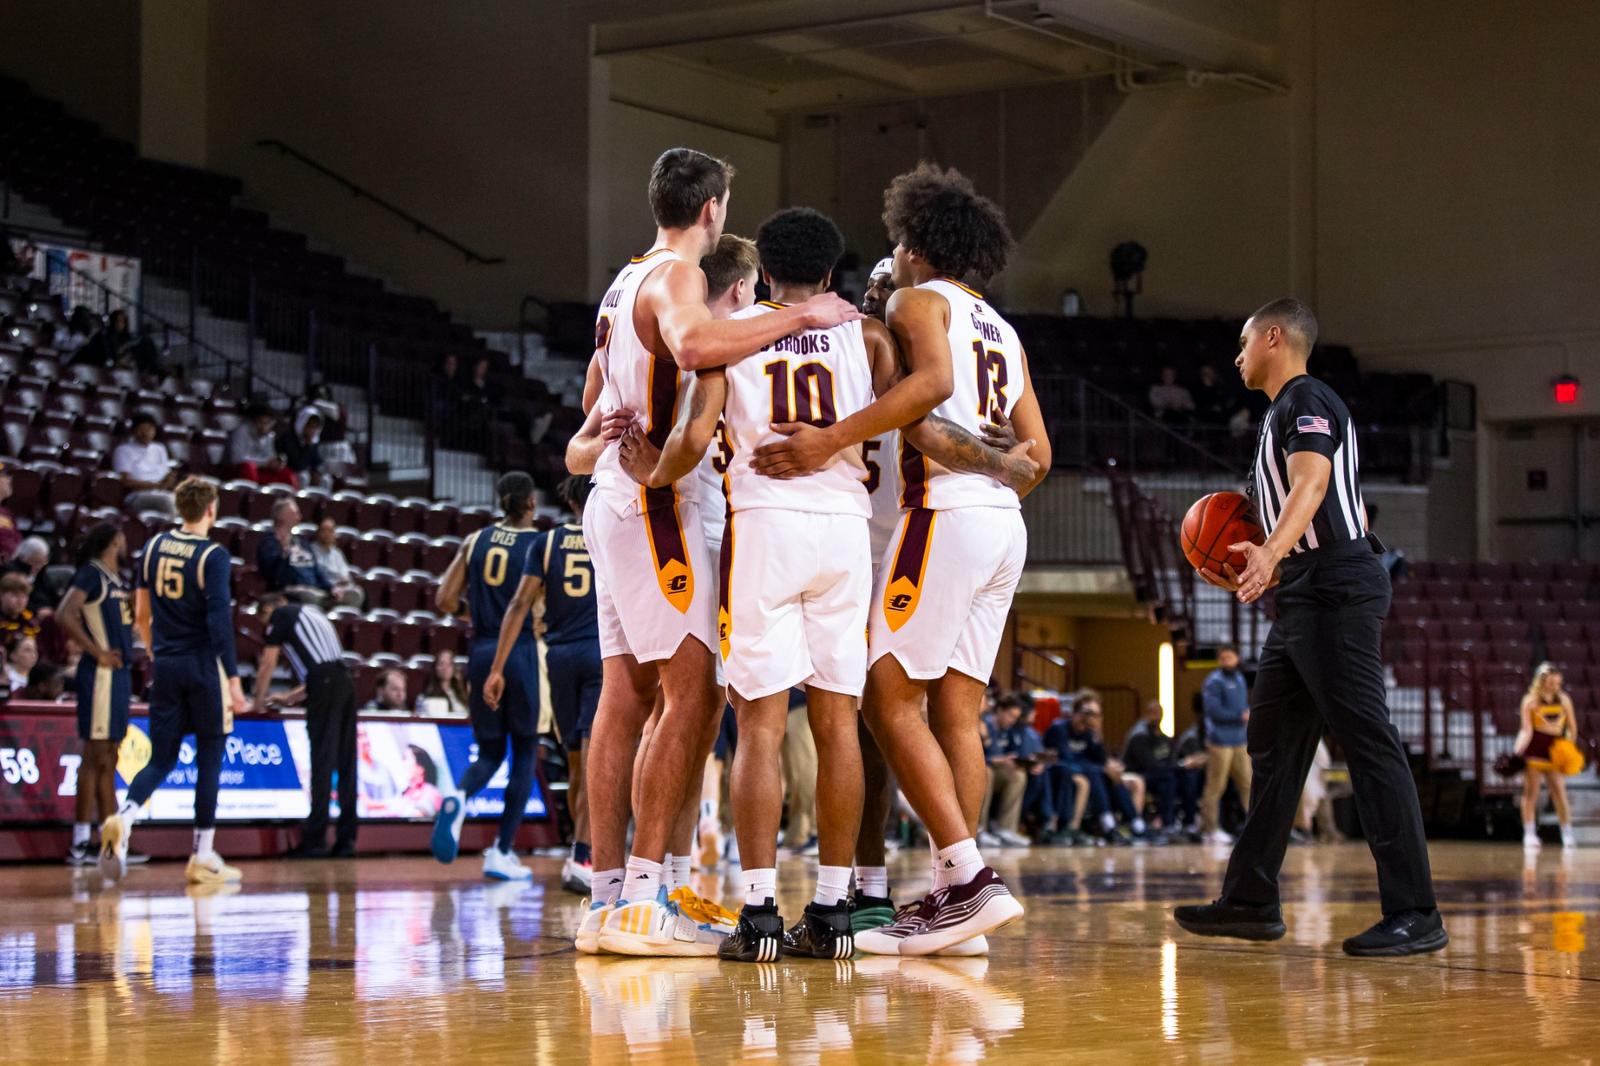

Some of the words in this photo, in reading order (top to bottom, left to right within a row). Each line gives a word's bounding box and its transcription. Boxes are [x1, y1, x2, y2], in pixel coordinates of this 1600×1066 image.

[774, 334, 830, 355] BROOKS
[763, 358, 838, 428] 10
[972, 338, 1009, 427] 13
[490, 531, 517, 547] LYLES
[155, 556, 185, 600] 15
[483, 547, 509, 586] 0
[563, 553, 590, 597] 5
[225, 737, 282, 765] Place
